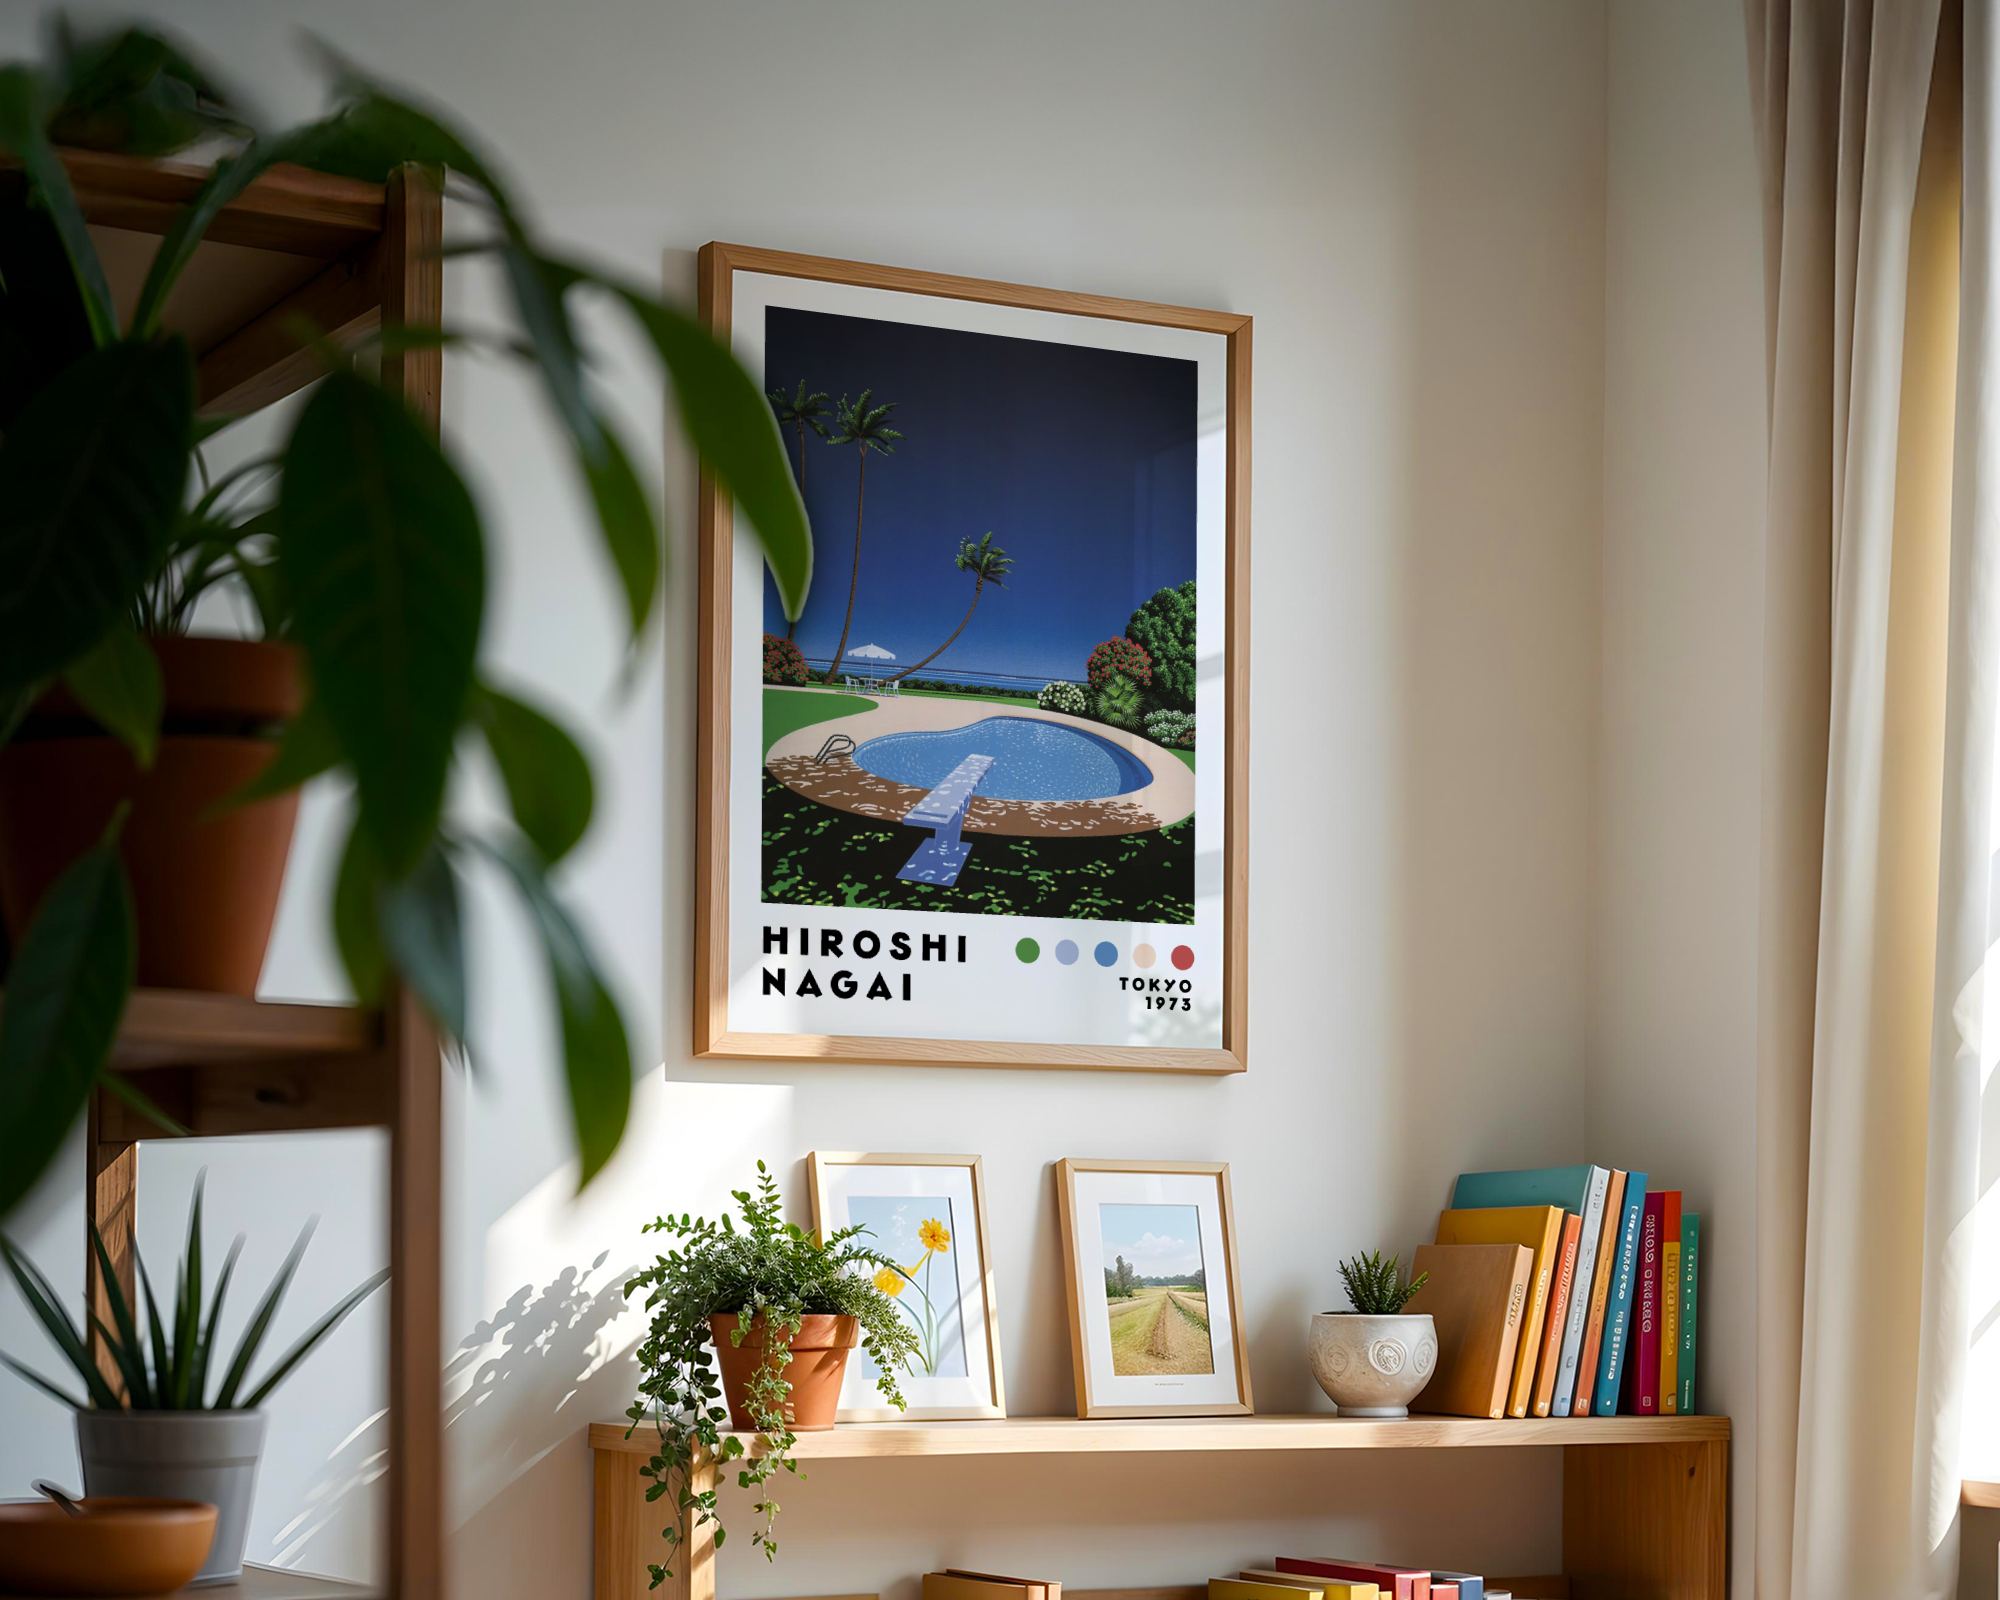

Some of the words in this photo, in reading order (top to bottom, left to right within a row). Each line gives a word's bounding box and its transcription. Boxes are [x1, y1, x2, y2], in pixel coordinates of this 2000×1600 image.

[762, 926, 968, 963] HIROSHI
[762, 966, 912, 1001] NAGAI
[1119, 977, 1192, 994] TOKYO
[1145, 996, 1191, 1012] 1973
